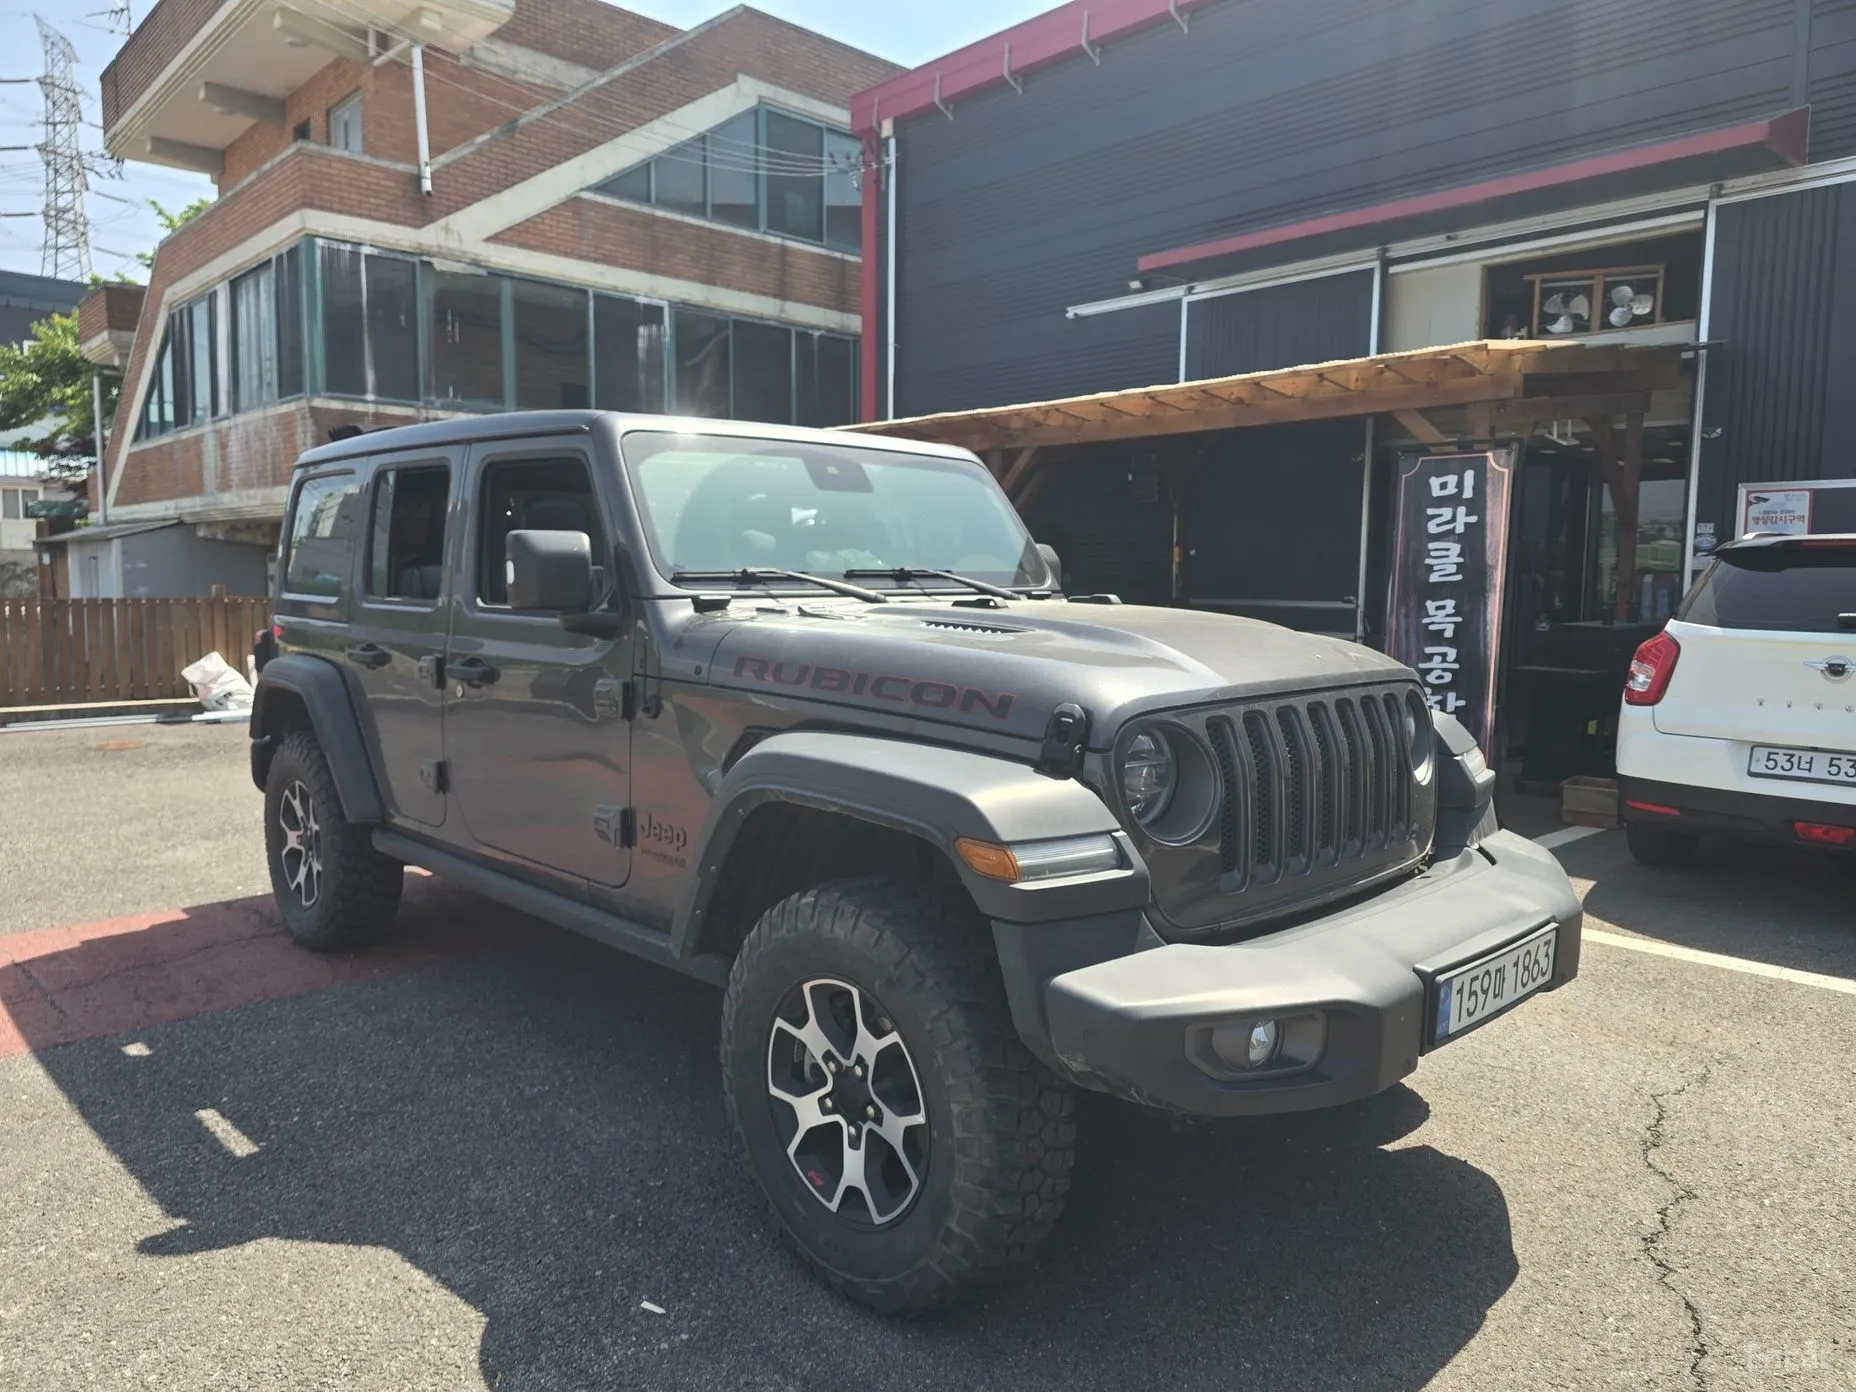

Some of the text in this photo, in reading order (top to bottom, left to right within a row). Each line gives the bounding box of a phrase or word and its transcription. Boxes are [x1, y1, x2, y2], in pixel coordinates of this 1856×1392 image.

[1424, 469, 1479, 583] 미라클
[731, 655, 1017, 720] RUBICON
[1764, 751, 1814, 774] 53너
[640, 812, 688, 852] Jeep
[1456, 938, 1553, 1023] 159마 1863
